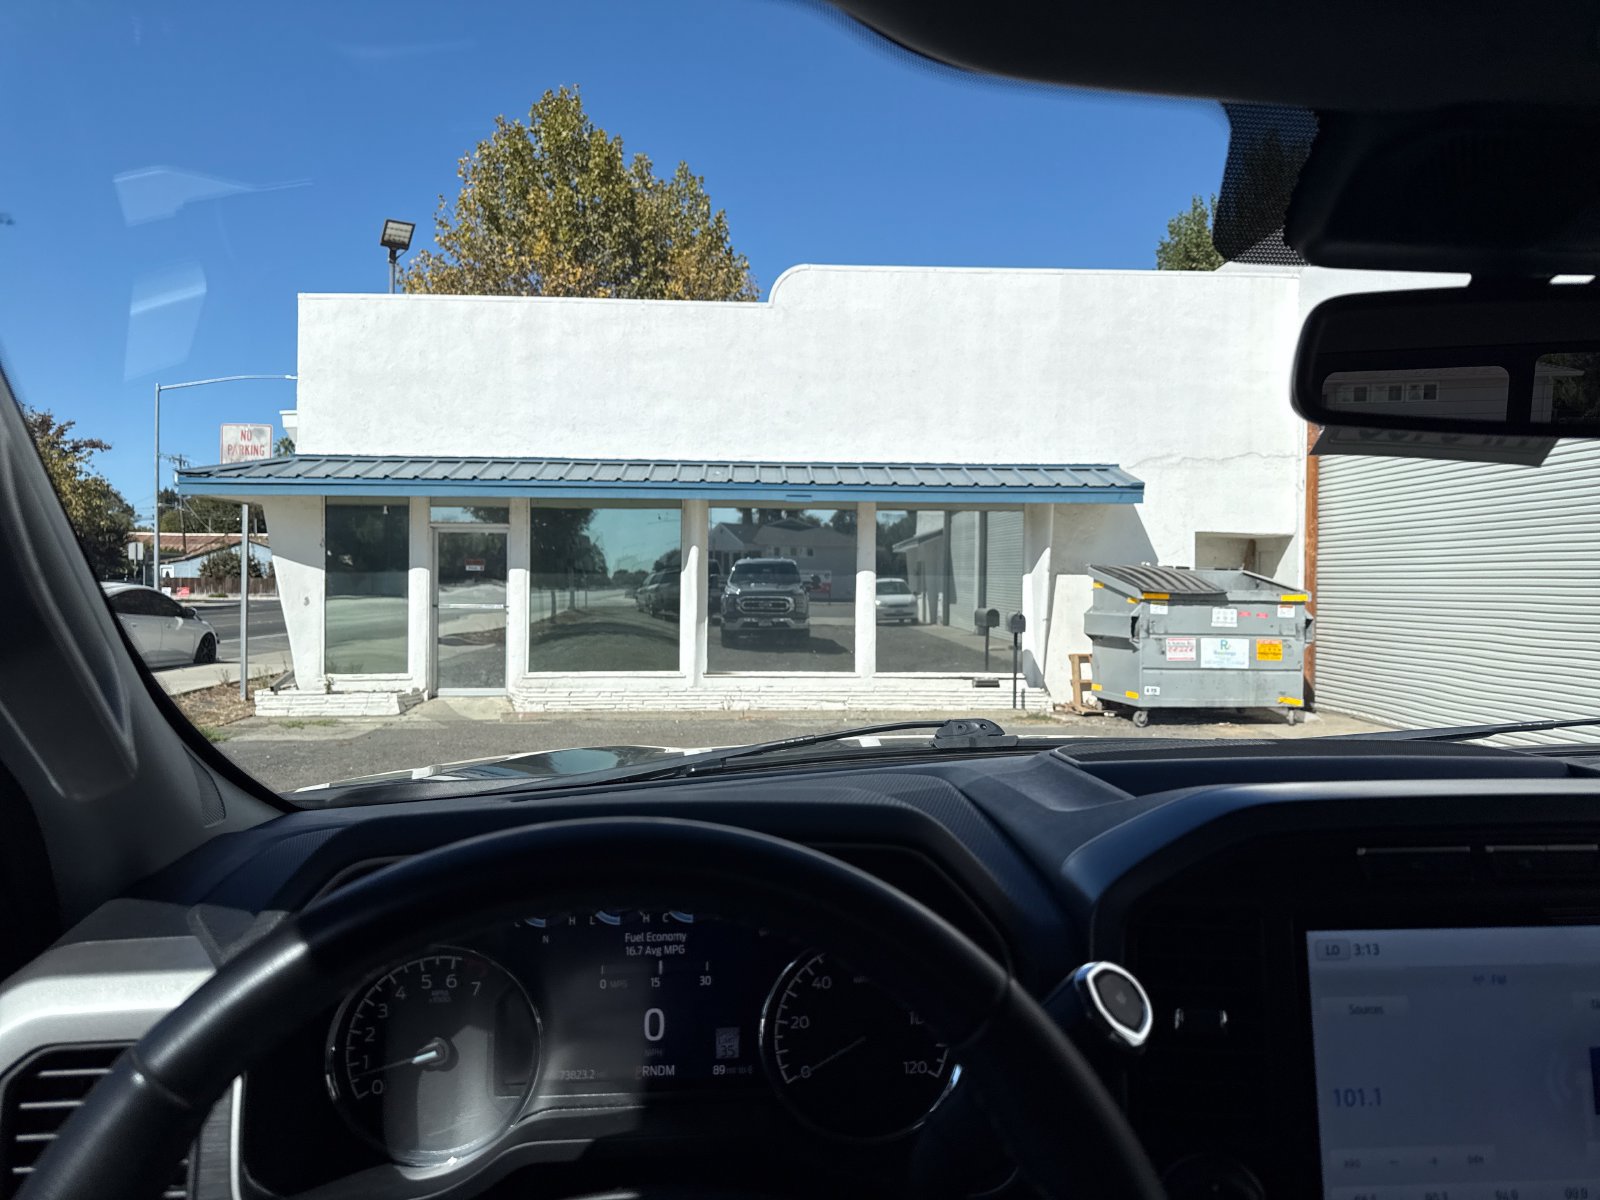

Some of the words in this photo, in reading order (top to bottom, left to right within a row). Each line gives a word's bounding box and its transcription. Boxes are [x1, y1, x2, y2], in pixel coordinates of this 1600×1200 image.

[240, 429, 252, 441] NO
[227, 444, 265, 456] PARKING
[568, 916, 576, 926] H
[624, 932, 645, 943] Fuel
[646, 931, 687, 943] Economy
[625, 946, 643, 956] 16.7
[645, 945, 662, 957] Avg
[664, 945, 685, 955] MPG
[1353, 943, 1380, 957] 3:13
[421, 974, 433, 990] 5
[445, 973, 457, 989] 6
[600, 979, 607, 989] 0
[650, 977, 661, 987] 15
[699, 976, 712, 986] 30
[811, 976, 832, 989] 40
[394, 985, 407, 1000] 4
[471, 981, 482, 997] 7
[377, 1003, 389, 1019] 3
[644, 1007, 665, 1042] 0
[790, 1016, 810, 1029] 20
[364, 1027, 376, 1042] 2
[712, 1064, 726, 1075] 89
[903, 1061, 928, 1074] 120
[371, 1080, 384, 1094] 0
[1333, 1087, 1382, 1107] 101.1
